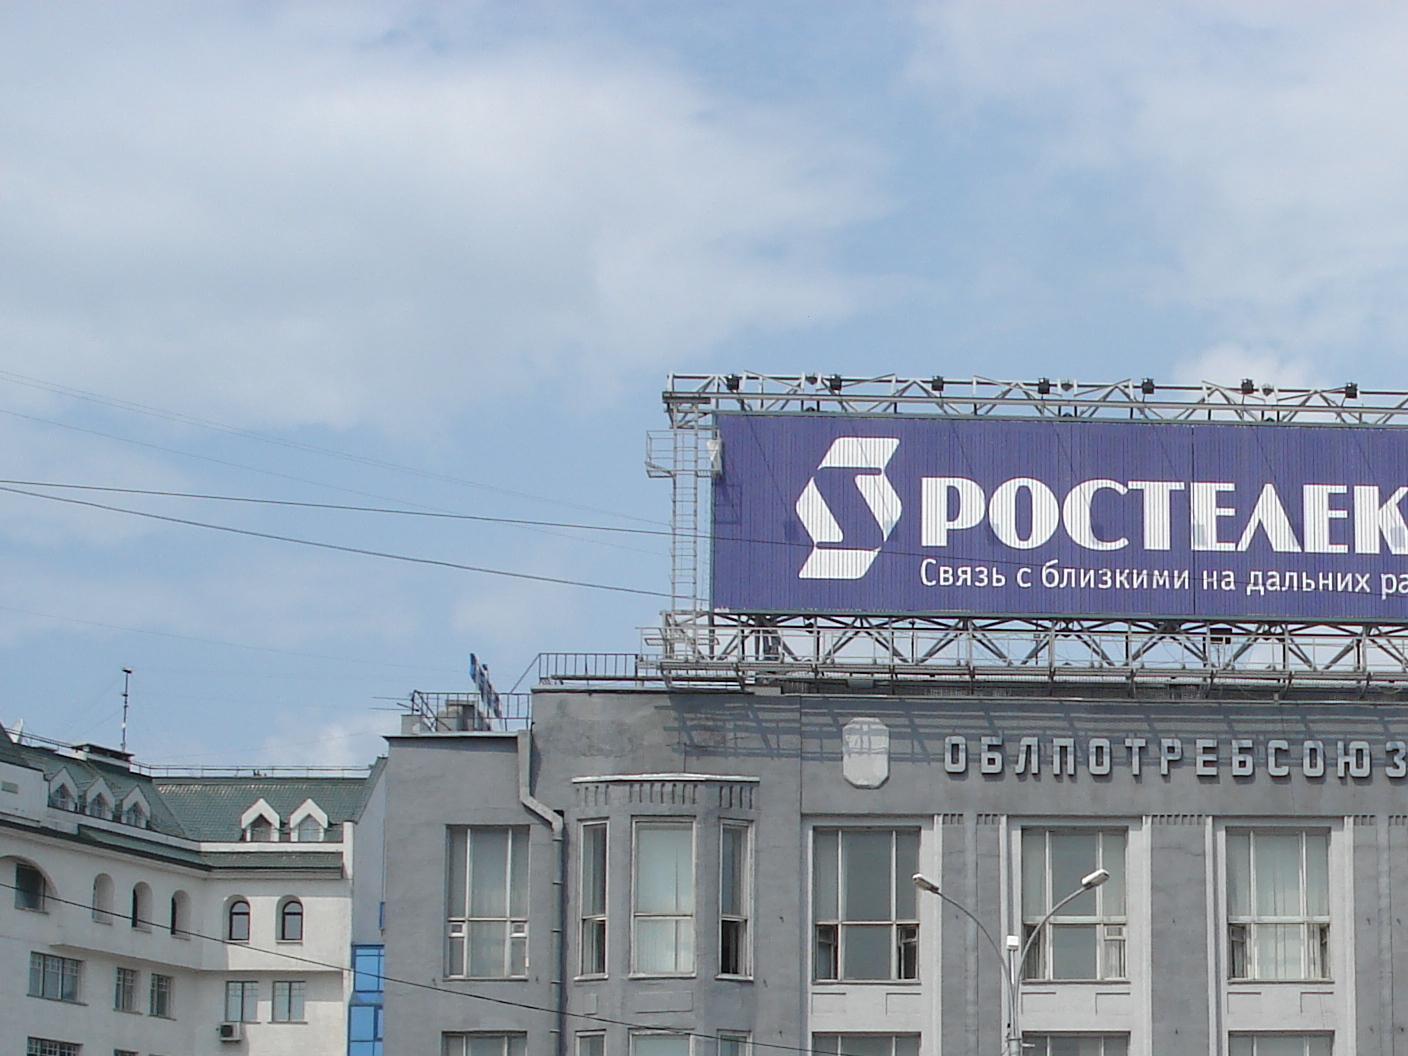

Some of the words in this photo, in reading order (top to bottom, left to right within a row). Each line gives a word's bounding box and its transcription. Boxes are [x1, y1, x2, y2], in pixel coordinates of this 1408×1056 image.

[919, 557, 1006, 592] Связь
[1016, 568, 1032, 589] с
[1042, 559, 1191, 592] близкими
[1203, 569, 1236, 591] на
[1247, 569, 1371, 596] дальних
[944, 734, 1408, 780] ОБЛПОТРЕБСОЮЗ
